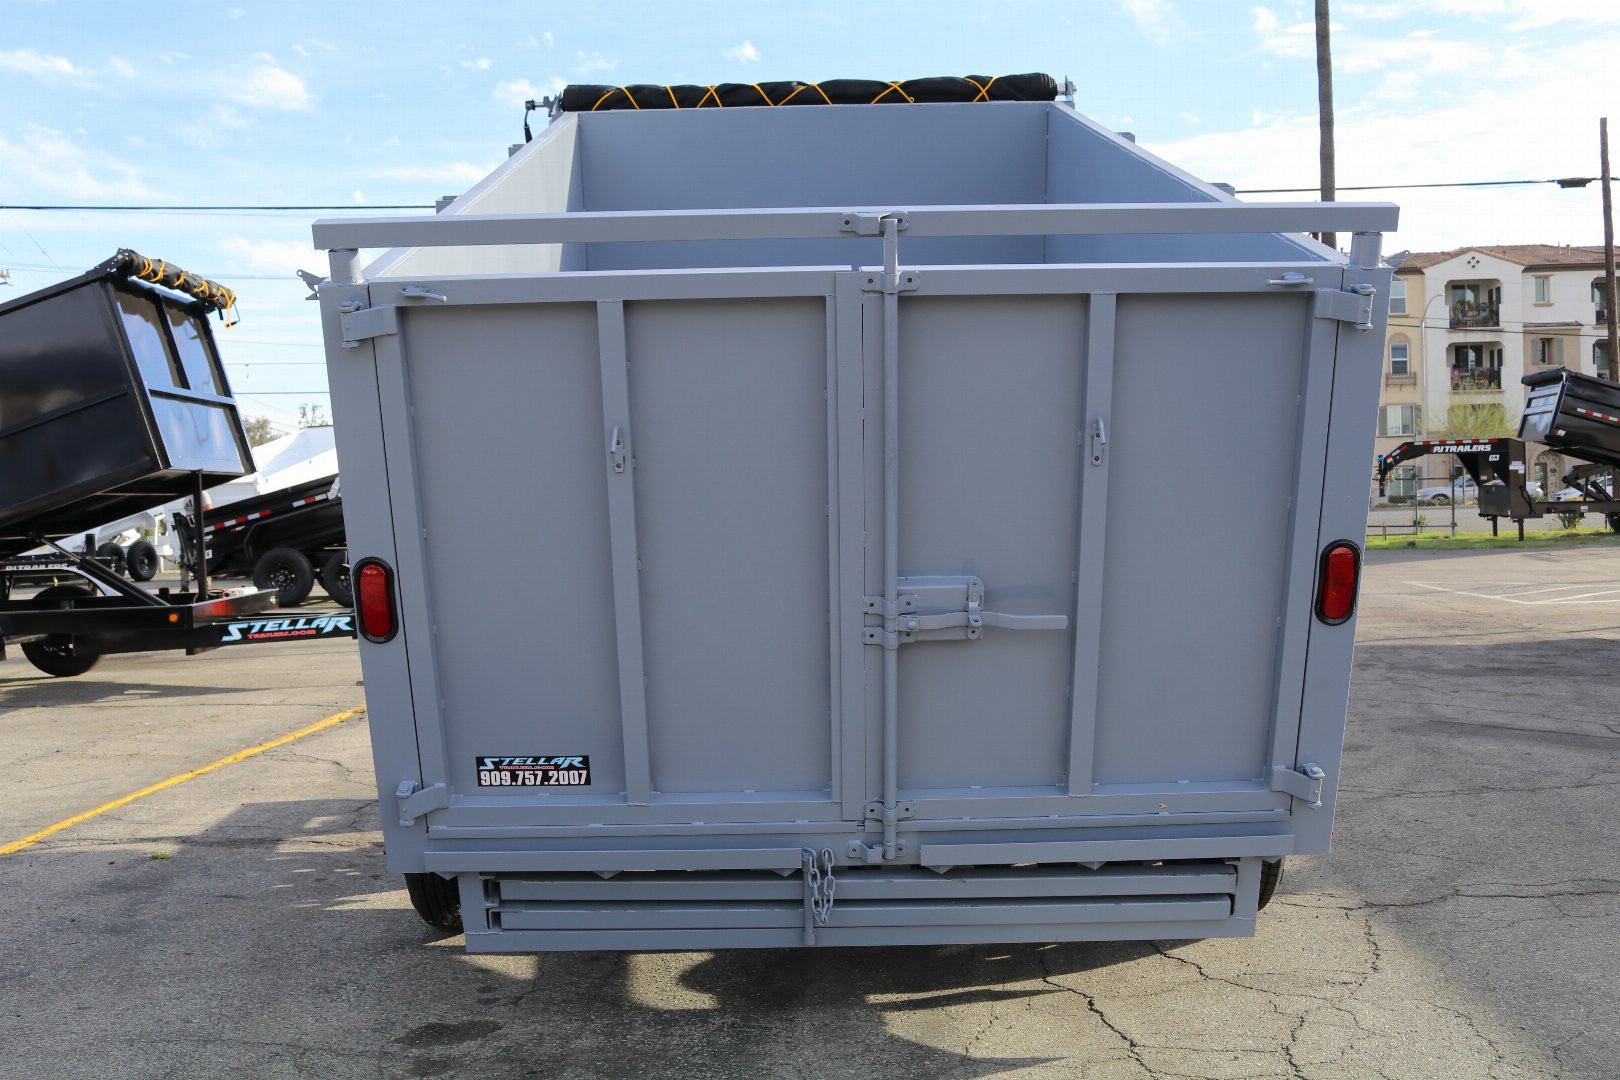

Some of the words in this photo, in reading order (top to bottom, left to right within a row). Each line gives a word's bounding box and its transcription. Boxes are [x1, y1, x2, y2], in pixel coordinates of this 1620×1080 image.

[221, 616, 354, 641] STELLAR
[479, 756, 586, 770] STELLAR
[480, 770, 587, 785] 909.757.2007
